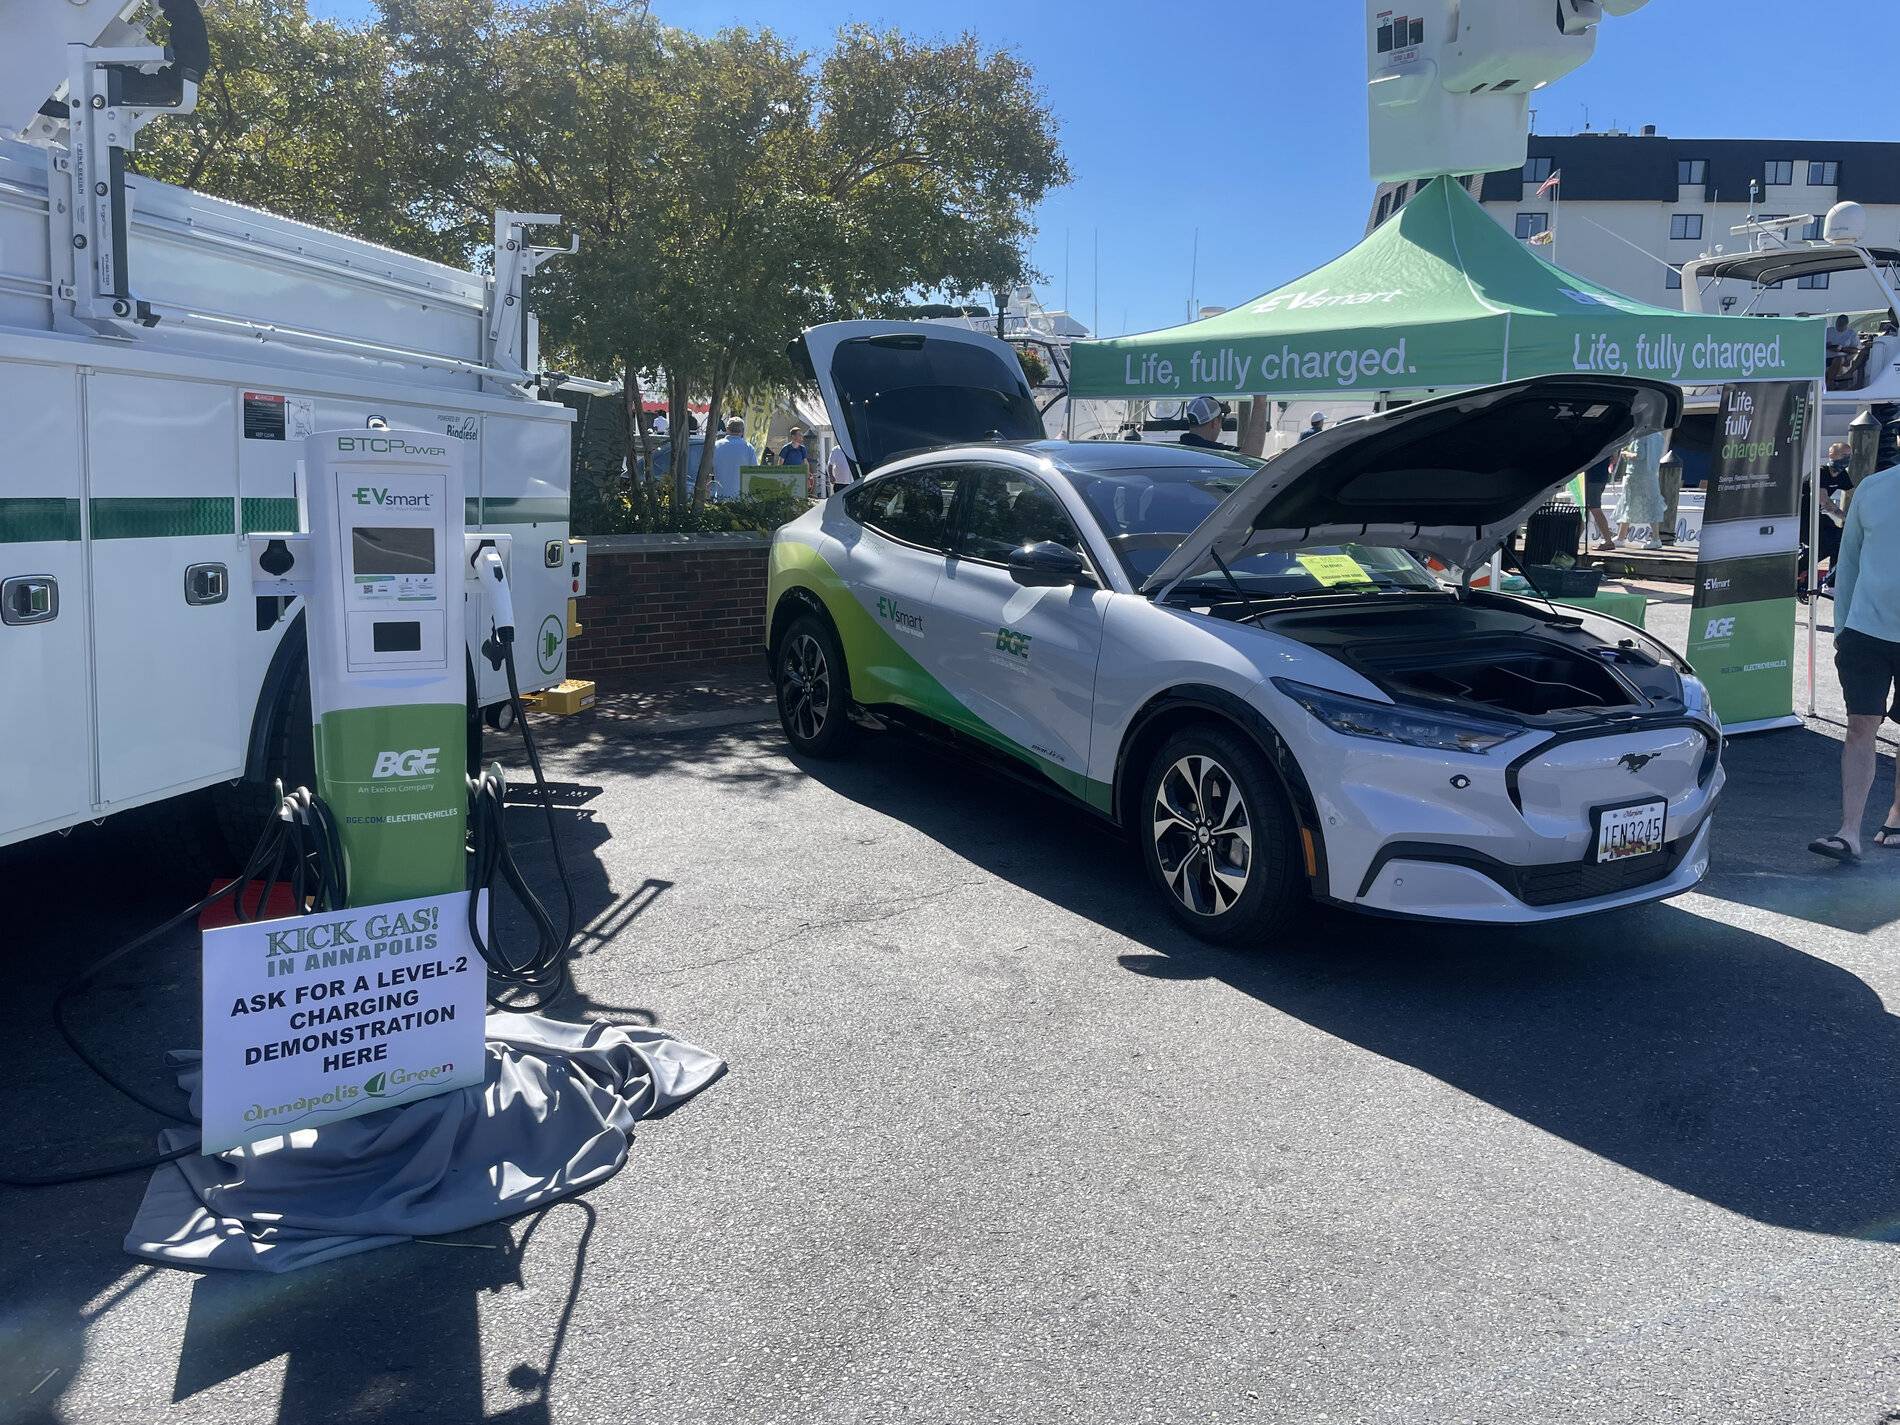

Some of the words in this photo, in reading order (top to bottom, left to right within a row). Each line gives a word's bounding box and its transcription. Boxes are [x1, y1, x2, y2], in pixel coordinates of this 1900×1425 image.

[1249, 288, 1403, 314] EVsmart
[1124, 353, 1180, 389] Life,
[1190, 348, 1251, 390] fully
[1260, 338, 1417, 386] charged.
[1572, 333, 1628, 375] Life,
[1636, 334, 1685, 378] fully
[1692, 334, 1785, 377] charged.
[1727, 391, 1754, 415] Life,
[446, 424, 479, 440] Biodiesel
[1725, 415, 1752, 440] fully
[1721, 437, 1779, 463] charged.
[352, 487, 431, 506] EVsmart
[1704, 578, 1730, 590] EVsmart
[876, 596, 923, 631] EVsmart
[1704, 617, 1735, 639] BGE
[996, 627, 1032, 659] BGE
[372, 748, 440, 778] BGE
[371, 786, 397, 794] Exelon
[399, 783, 434, 794] Company
[1604, 818, 1661, 852] 1EN3245
[265, 920, 358, 957] KICK
[365, 907, 439, 940] GAS!
[267, 958, 295, 977] IN
[304, 934, 437, 971] ANNAPOLIS
[230, 990, 286, 1017] ASK
[295, 980, 345, 1004] FOR
[353, 976, 370, 994] A
[377, 956, 468, 988] LEVEL-2
[290, 990, 419, 1029] CHARGING
[244, 1005, 456, 1066] DEMONSTRATION
[323, 1044, 388, 1073] HERE
[390, 1064, 453, 1085] Green
